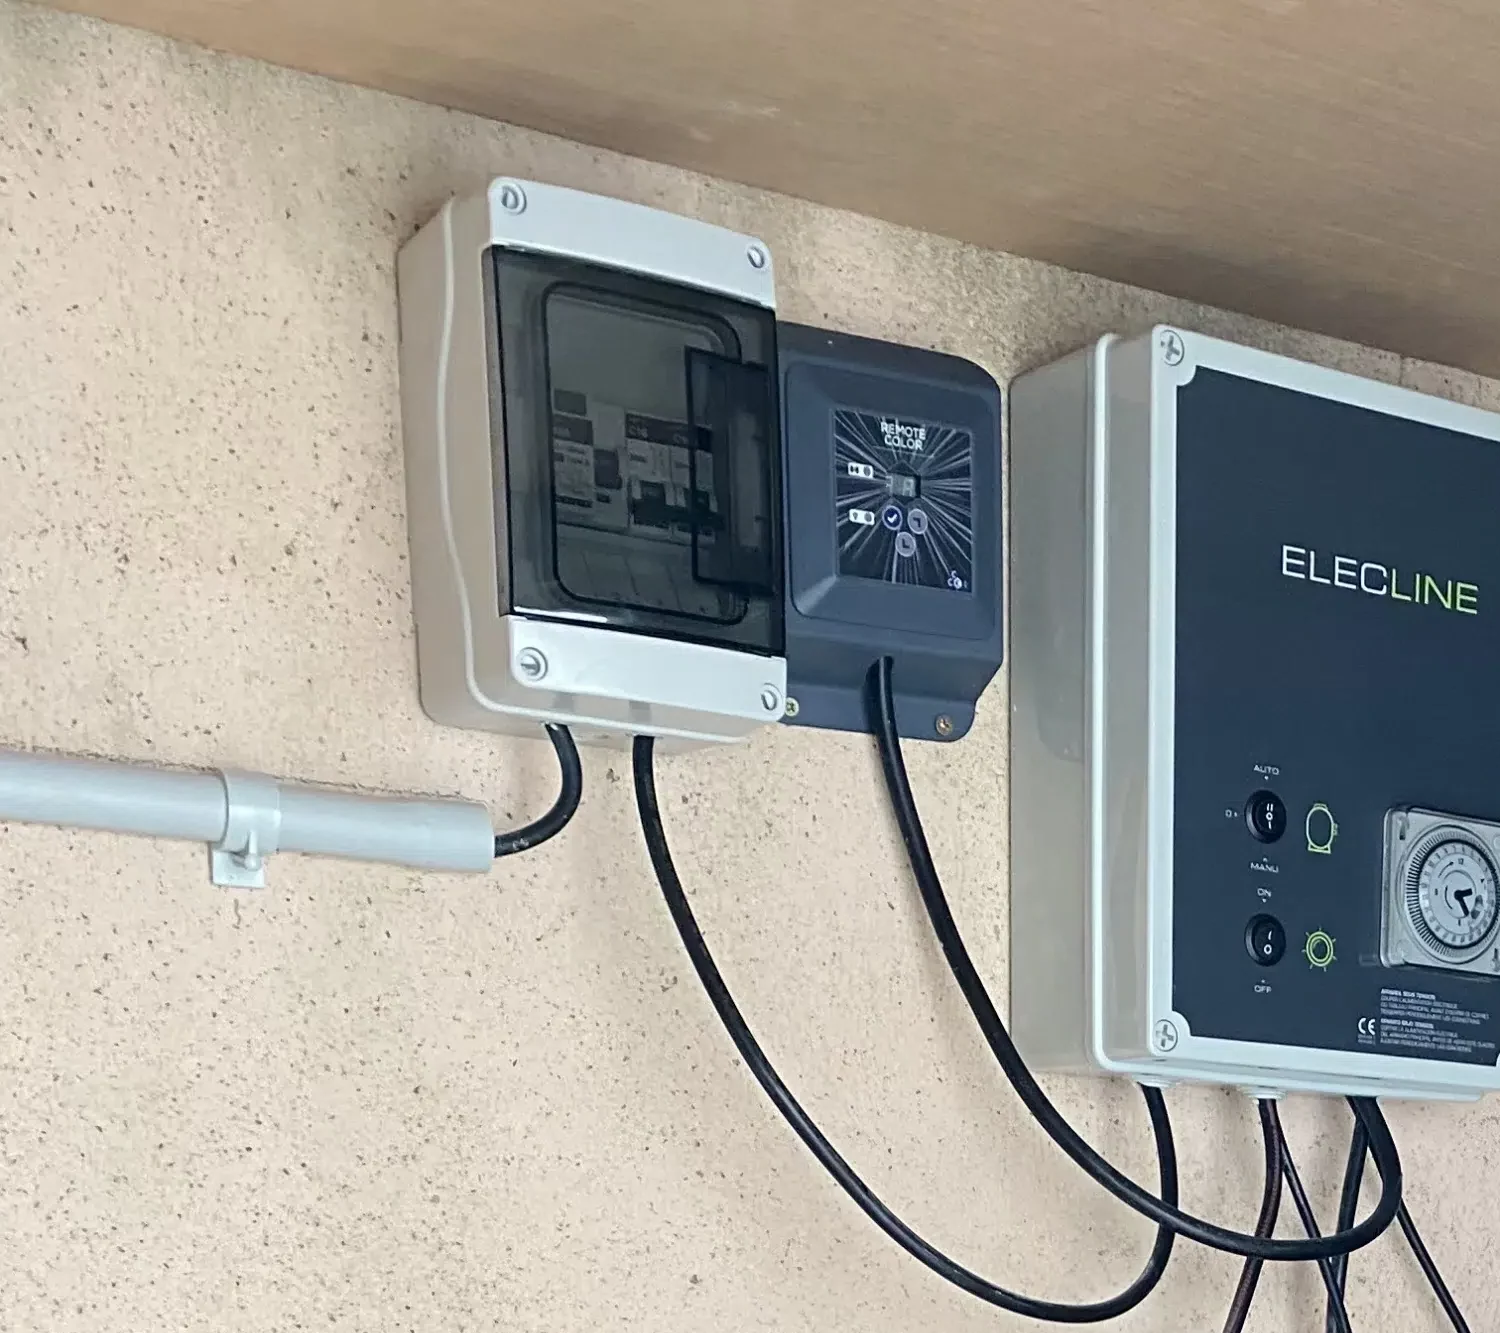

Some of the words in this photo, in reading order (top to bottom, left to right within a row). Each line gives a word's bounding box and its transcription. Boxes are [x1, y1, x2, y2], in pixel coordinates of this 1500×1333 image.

[880, 422, 926, 440] REMOTE
[884, 435, 923, 450] COLOR
[1282, 544, 1479, 614] ELECLINE
[1253, 764, 1280, 776] AUTO
[1250, 861, 1280, 873] MANU
[1257, 888, 1272, 898] ON
[1254, 984, 1272, 994] OFF
